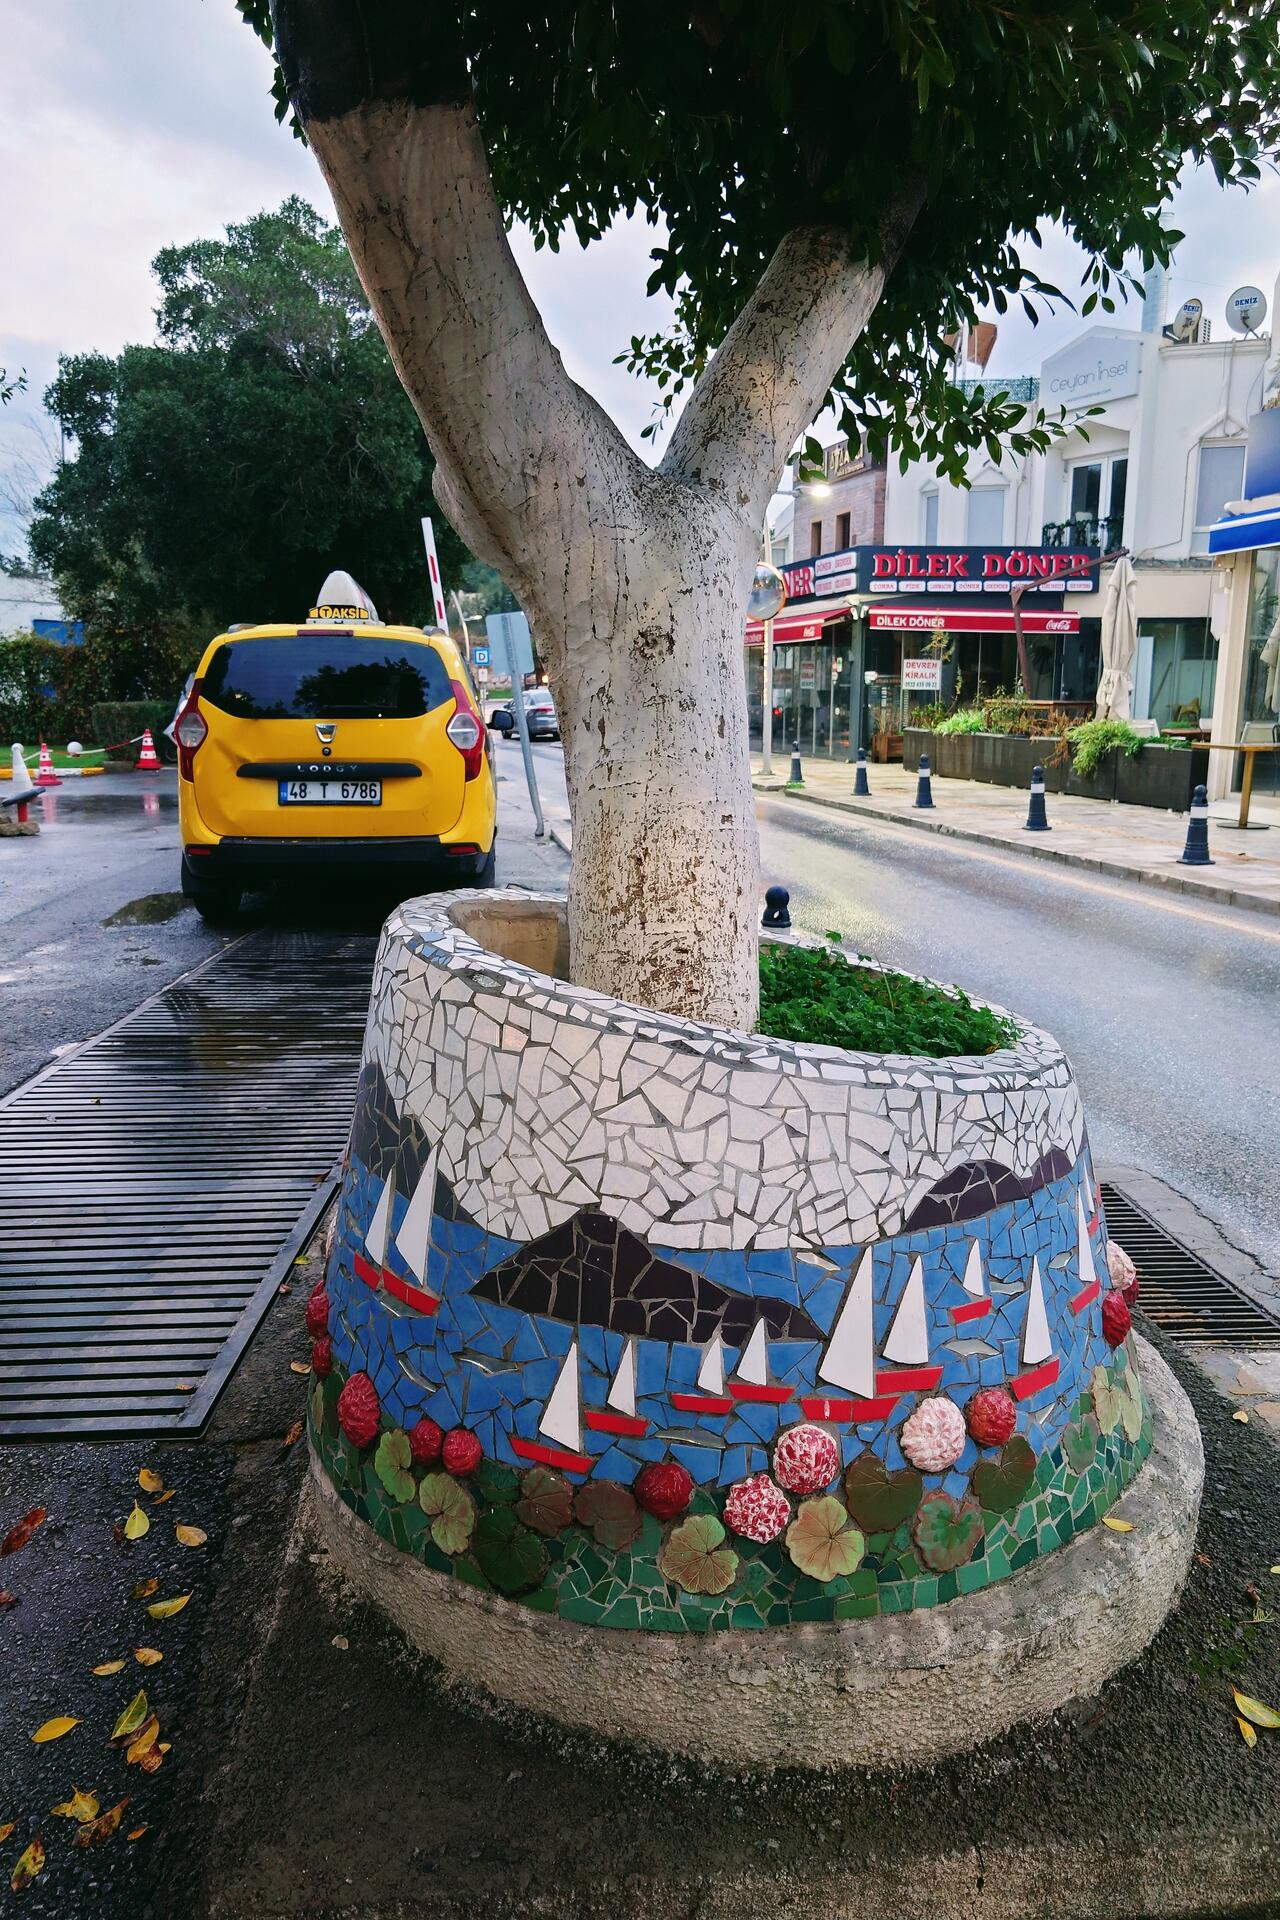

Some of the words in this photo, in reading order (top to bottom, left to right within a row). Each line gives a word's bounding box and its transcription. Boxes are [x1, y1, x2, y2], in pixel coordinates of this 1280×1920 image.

[872, 548, 969, 577] DİLEK
[982, 550, 1090, 577] DÖNER
[876, 615, 907, 627] DİLEK
[908, 615, 945, 628] DÖNER
[479, 653, 486, 661] D
[905, 661, 938, 669] DEVREN
[297, 764, 358, 773] LODGY
[289, 782, 308, 799] 48
[320, 782, 329, 799] T
[341, 782, 378, 799] 6786
